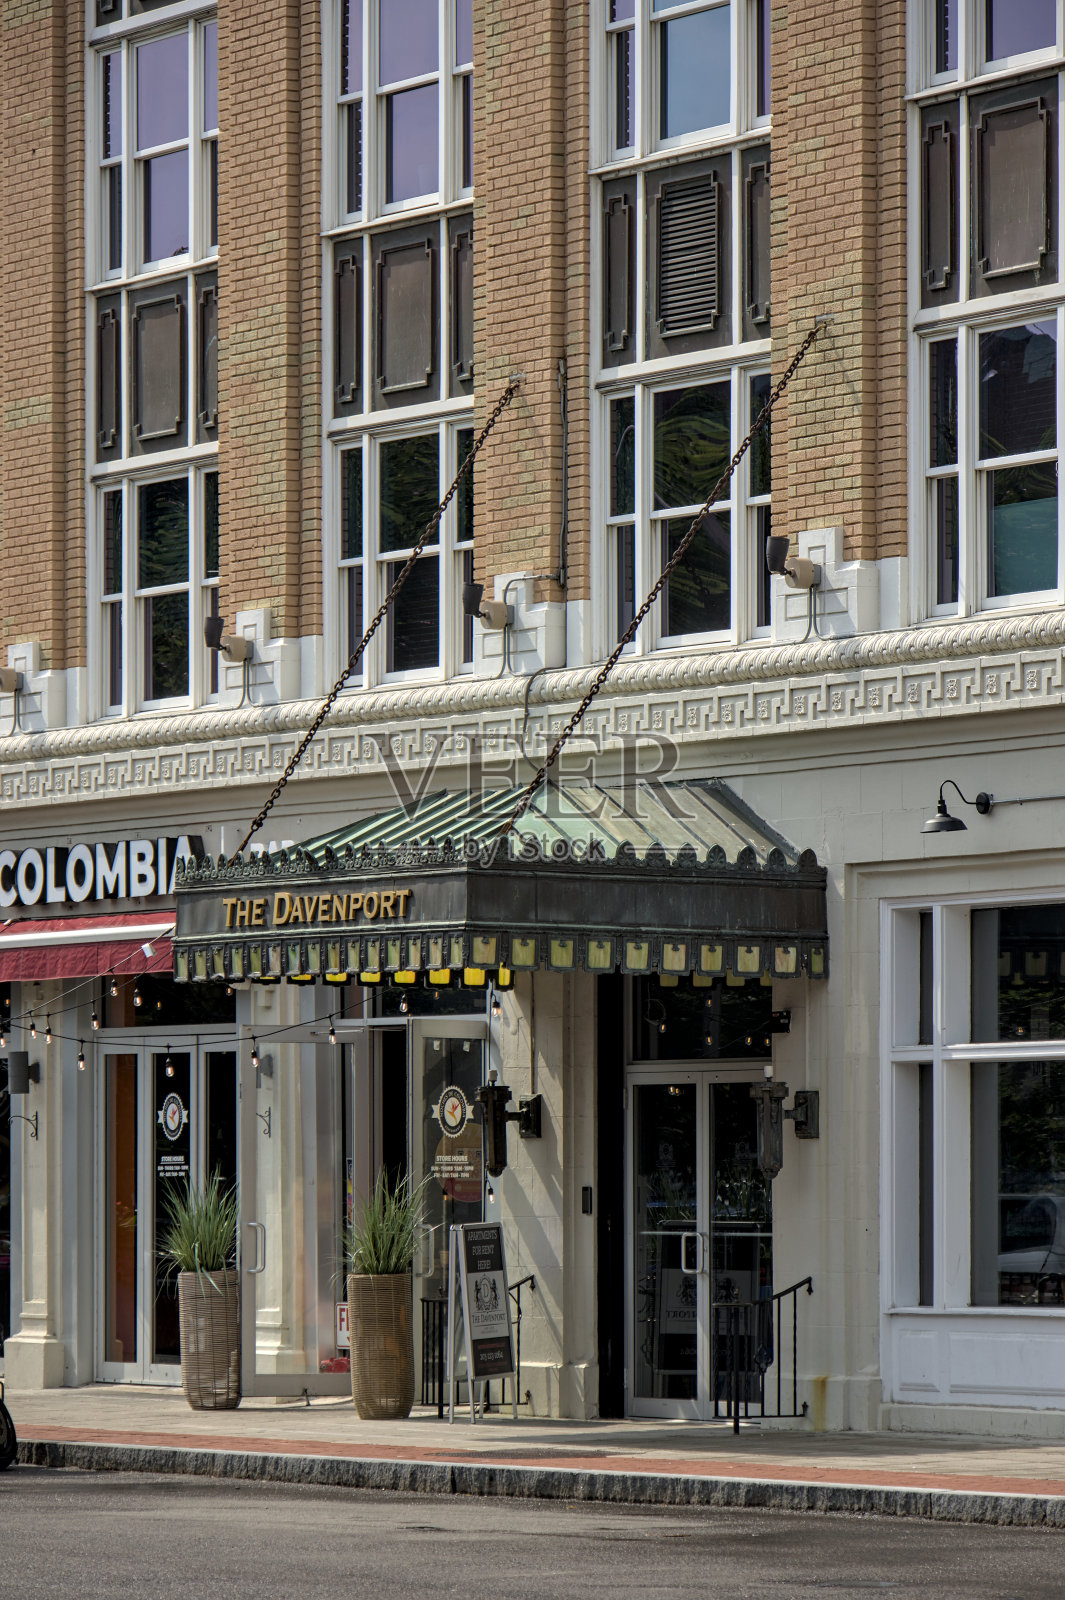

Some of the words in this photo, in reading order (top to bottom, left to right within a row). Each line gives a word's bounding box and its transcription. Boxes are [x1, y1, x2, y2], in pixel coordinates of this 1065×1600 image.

[0, 835, 196, 907] COLOMBIA
[223, 897, 267, 927] THE
[272, 889, 412, 925] DAVENPORT
